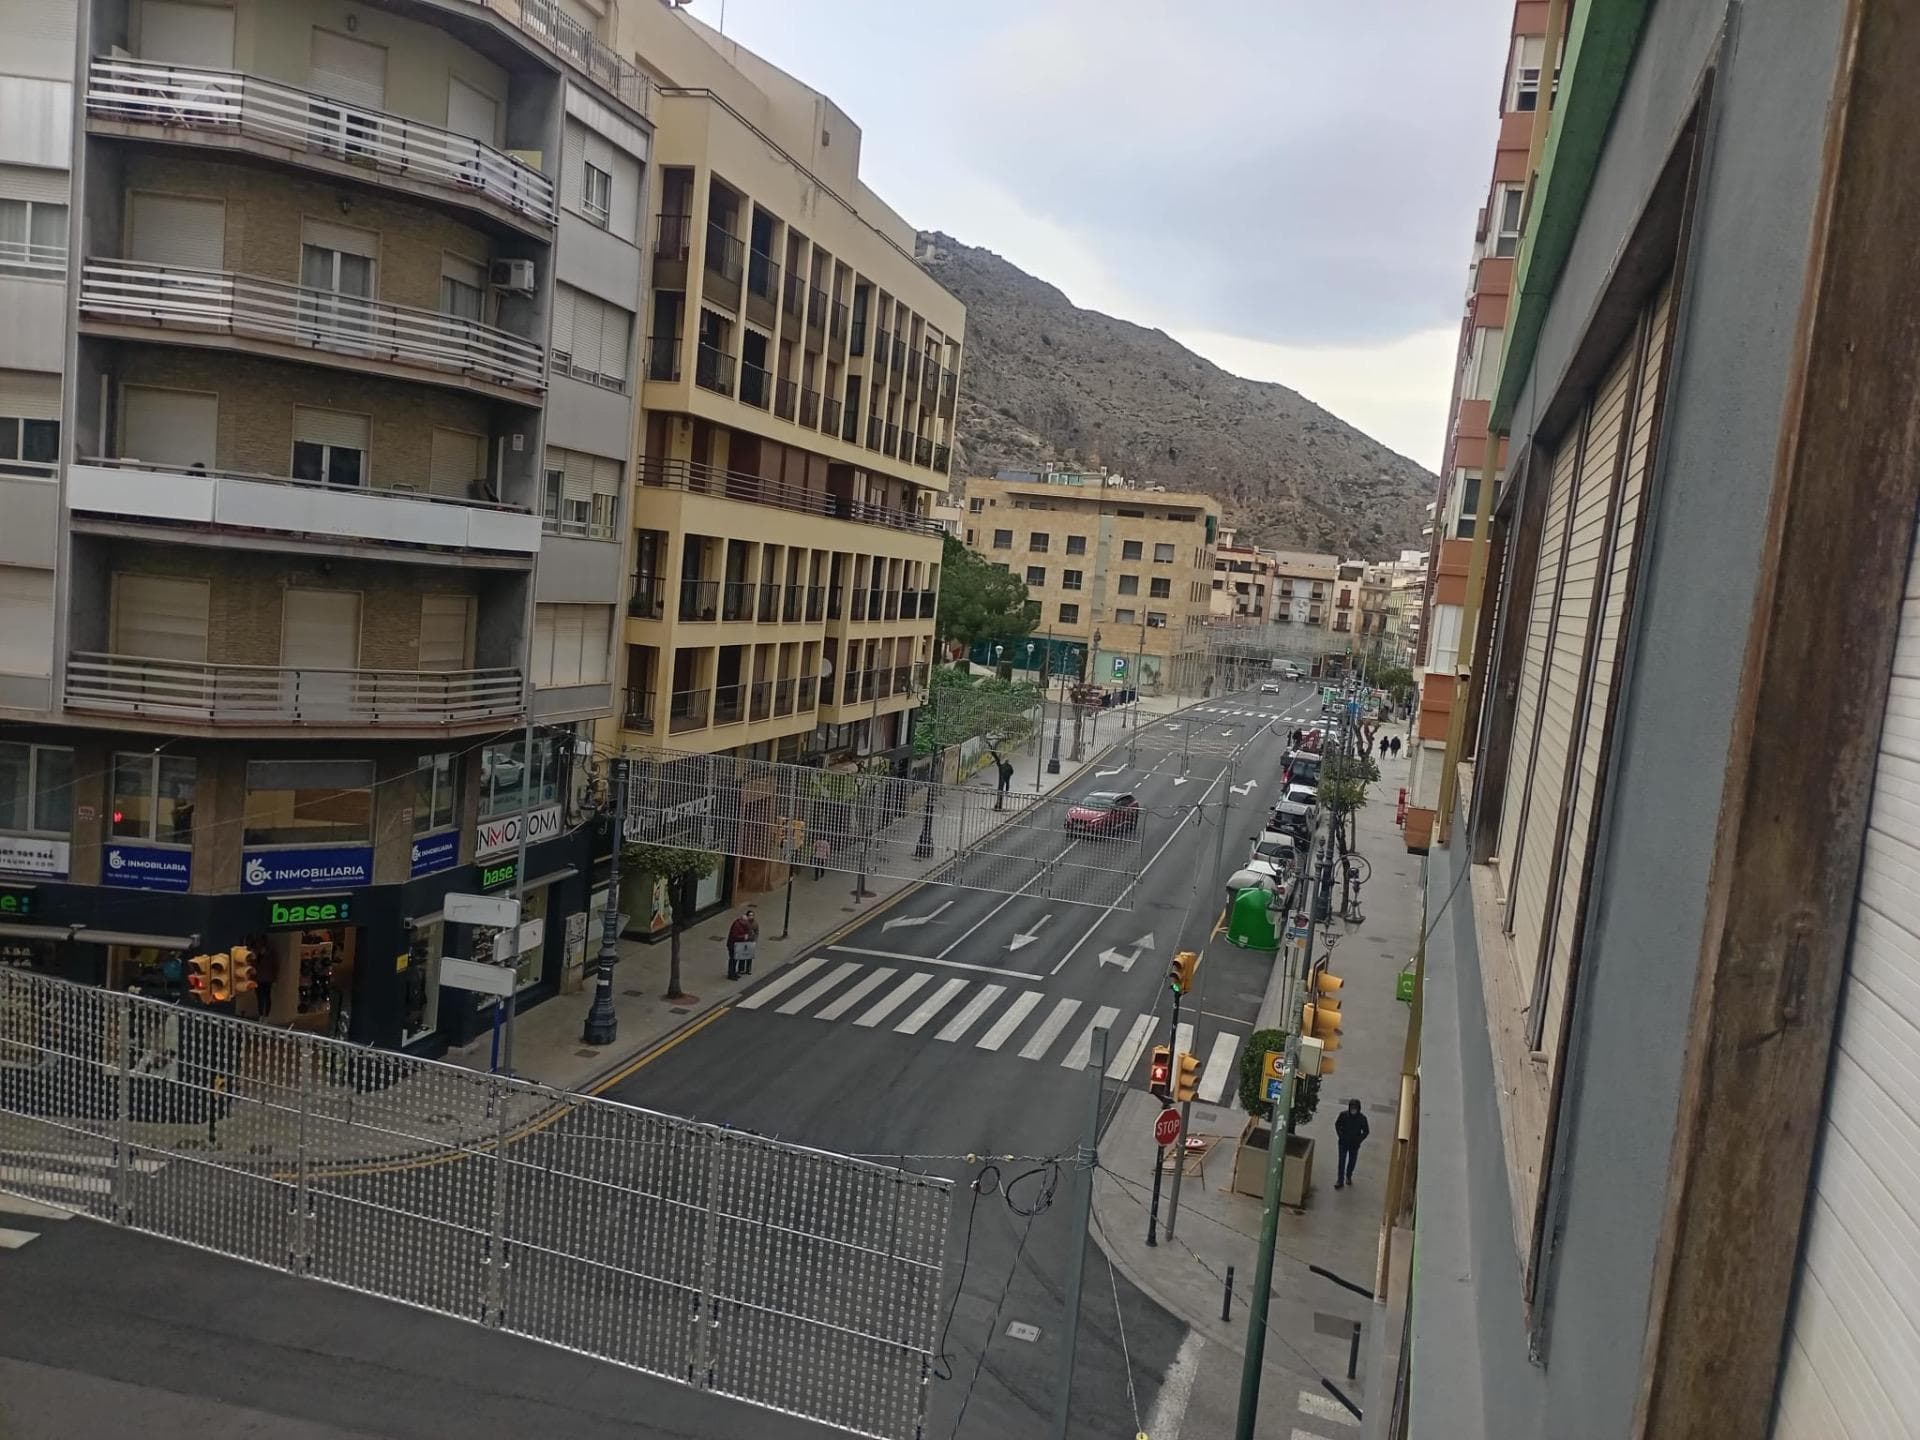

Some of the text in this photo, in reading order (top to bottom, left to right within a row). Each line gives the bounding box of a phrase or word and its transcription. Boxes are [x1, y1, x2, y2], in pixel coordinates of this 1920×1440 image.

[422, 843, 453, 856] INMOBILIARIA
[127, 860, 187, 872] INMOBILIARIA
[275, 865, 364, 880] INMOBILIARIA
[1157, 1120, 1180, 1136] STOP
